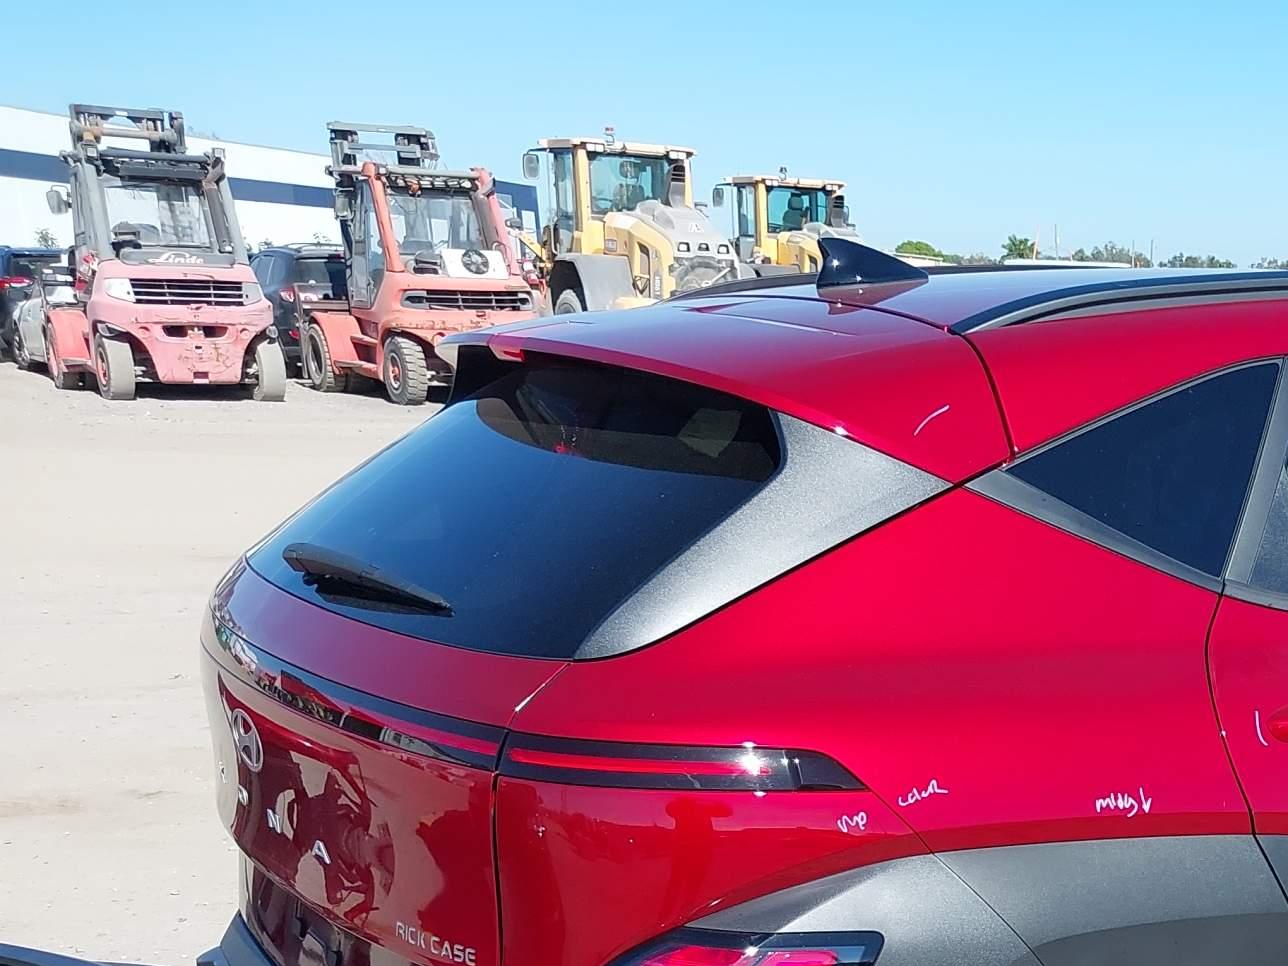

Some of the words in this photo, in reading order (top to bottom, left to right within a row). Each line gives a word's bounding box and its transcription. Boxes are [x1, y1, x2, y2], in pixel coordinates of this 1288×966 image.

[148, 251, 204, 265] Linde
[395, 920, 428, 950] RICK
[430, 933, 478, 966] CASE
